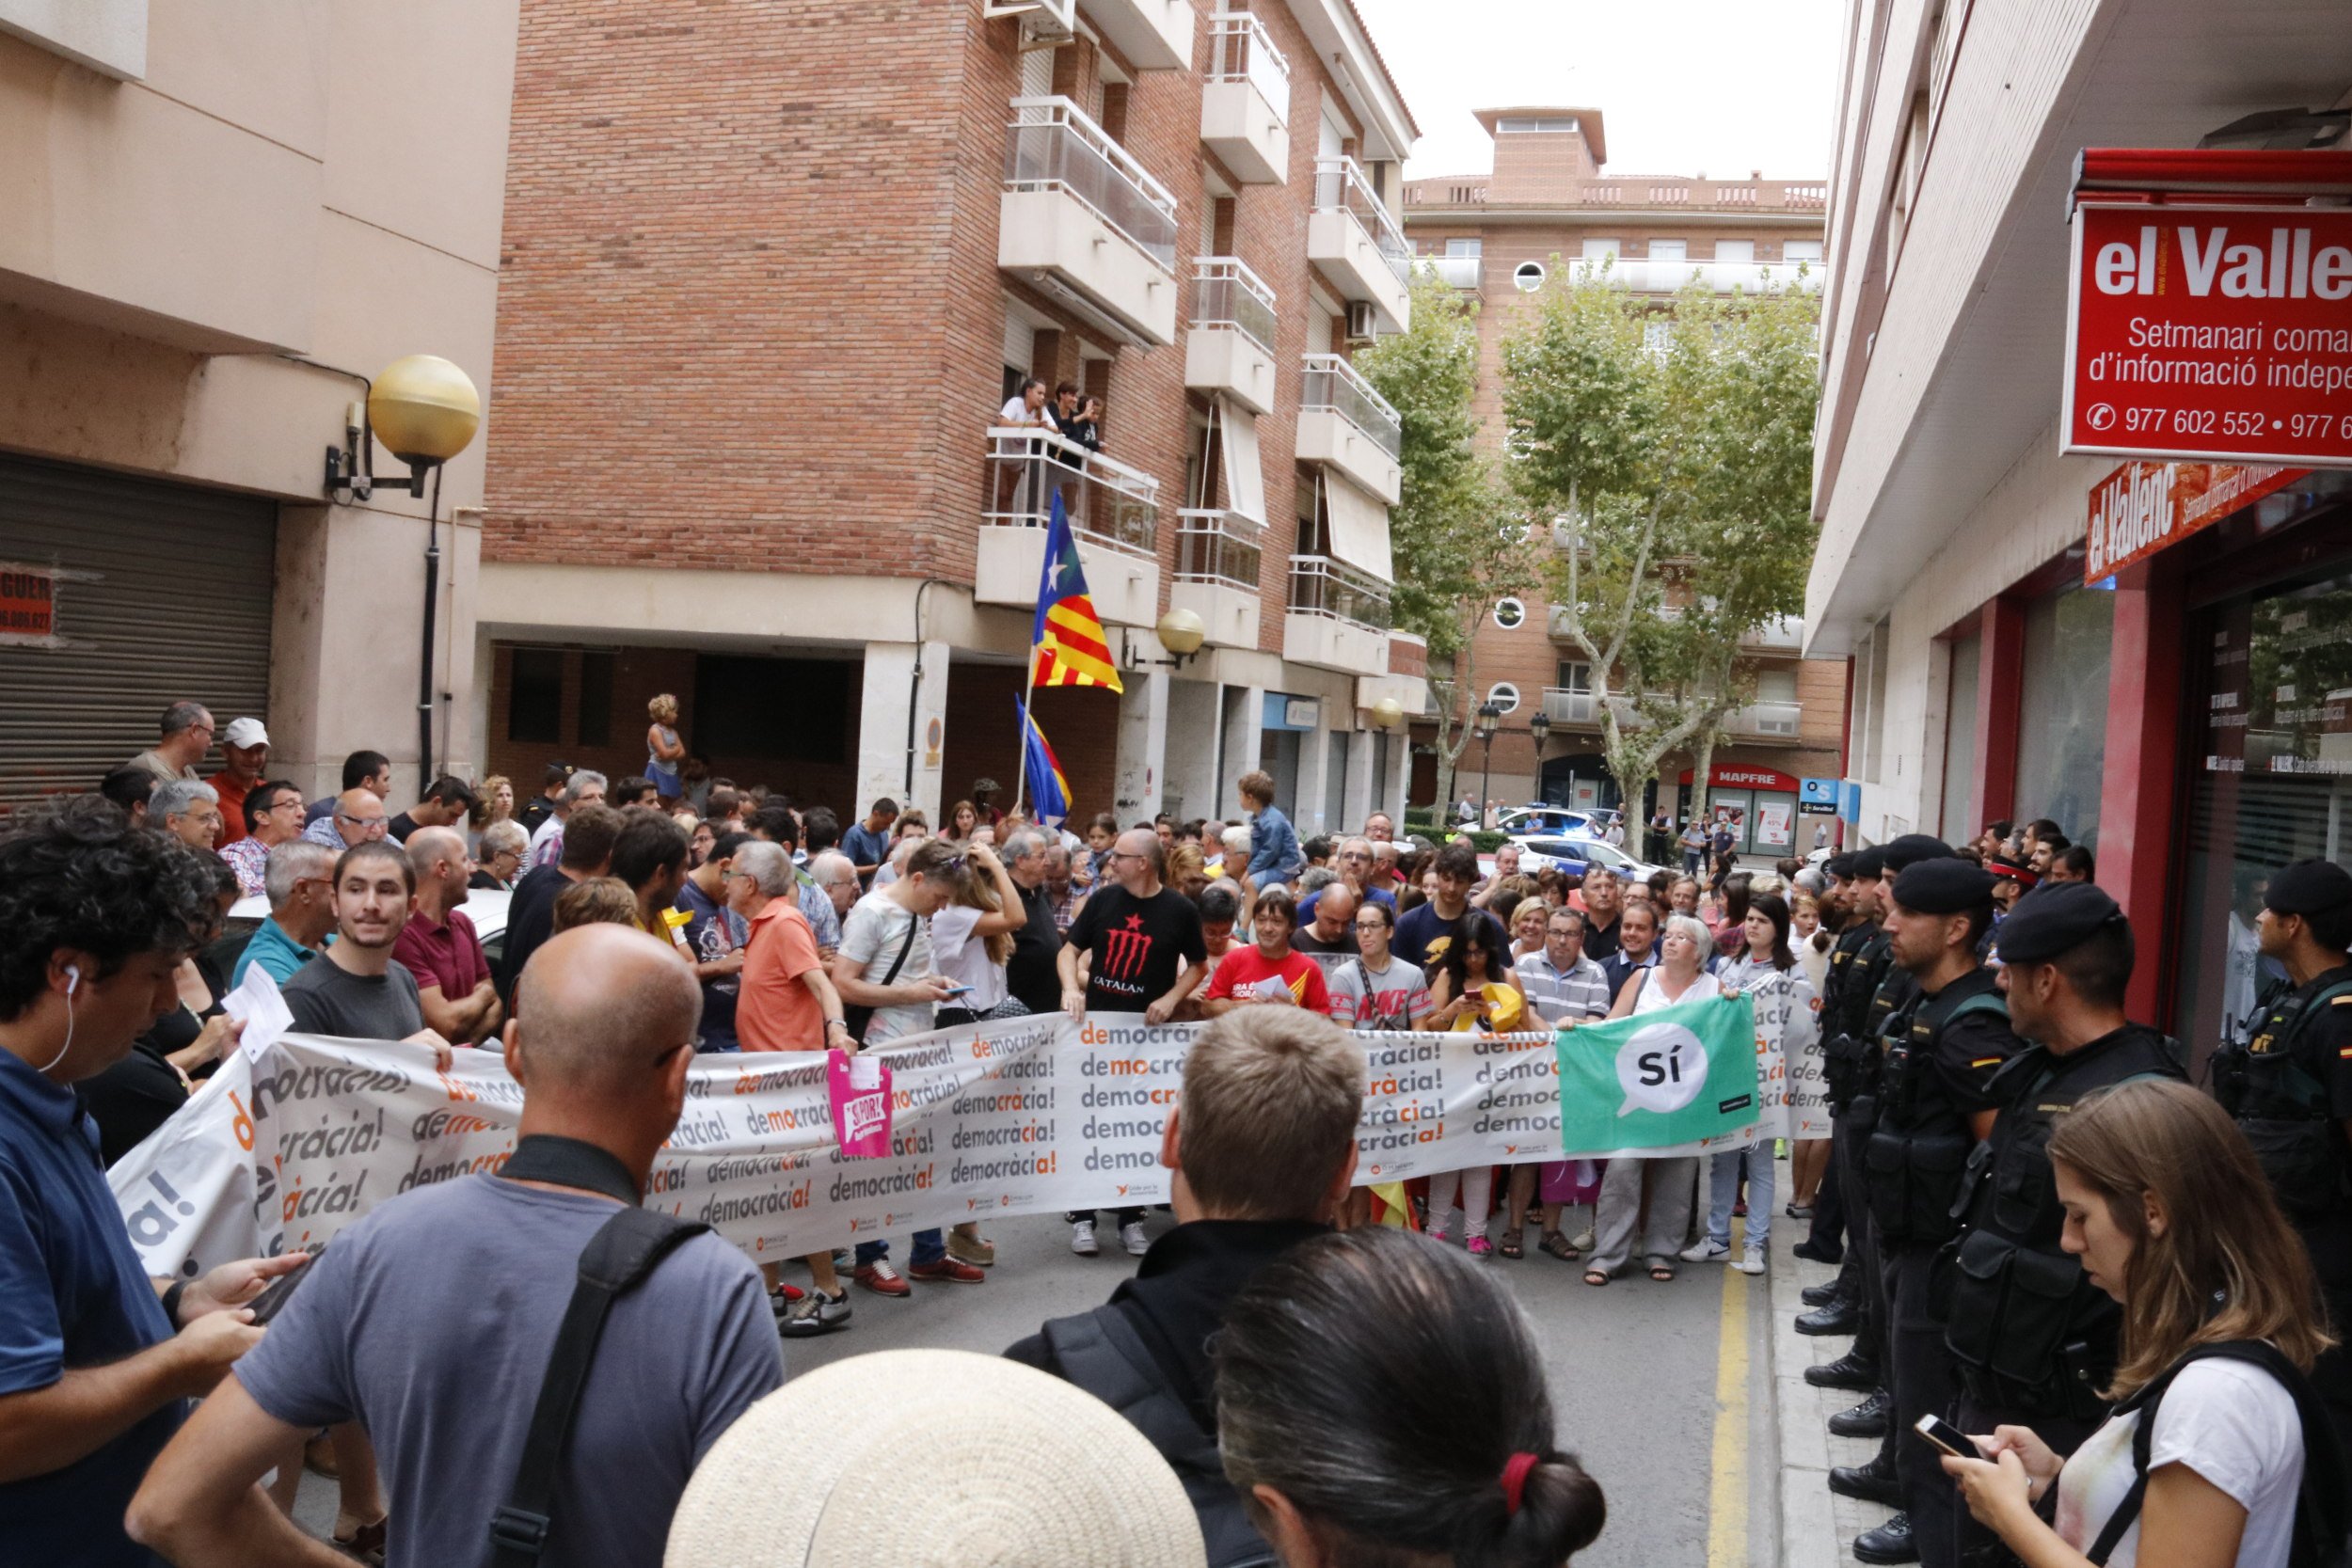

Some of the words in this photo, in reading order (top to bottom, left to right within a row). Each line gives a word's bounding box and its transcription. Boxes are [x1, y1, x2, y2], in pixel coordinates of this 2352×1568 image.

[2095, 226, 2157, 295] el
[2178, 227, 2352, 300] Valle
[2128, 316, 2264, 351] Setmanari
[2267, 358, 2352, 395] indepe
[2125, 408, 2167, 433] 977
[2173, 410, 2217, 435] 602
[2222, 412, 2265, 436] 552
[2290, 415, 2332, 439] 977
[2341, 417, 2352, 439] 6
[2089, 488, 2107, 575] el
[2106, 461, 2176, 565] Vallenc
[1719, 771, 1776, 784] MAPFRE
[1817, 784, 1832, 800] S
[1093, 975, 1145, 993] CATALAN
[1369, 1041, 1441, 1067] ràcia!
[1638, 1045, 1683, 1086] Sí
[1081, 1084, 1176, 1108] democr
[1363, 1069, 1443, 1097] ràcia!
[952, 1085, 1055, 1116] democràcia!
[1360, 1099, 1445, 1127] cràcia!
[1477, 1090, 1561, 1111] democ
[951, 1118, 1055, 1149] democràcia!
[1082, 1115, 1164, 1139] democ
[1358, 1122, 1444, 1152] cràcia!
[1473, 1116, 1561, 1134] democ
[950, 1149, 1057, 1184] democràcia!
[829, 1163, 934, 1203] democràcia!
[700, 1179, 812, 1224] democràcia!
